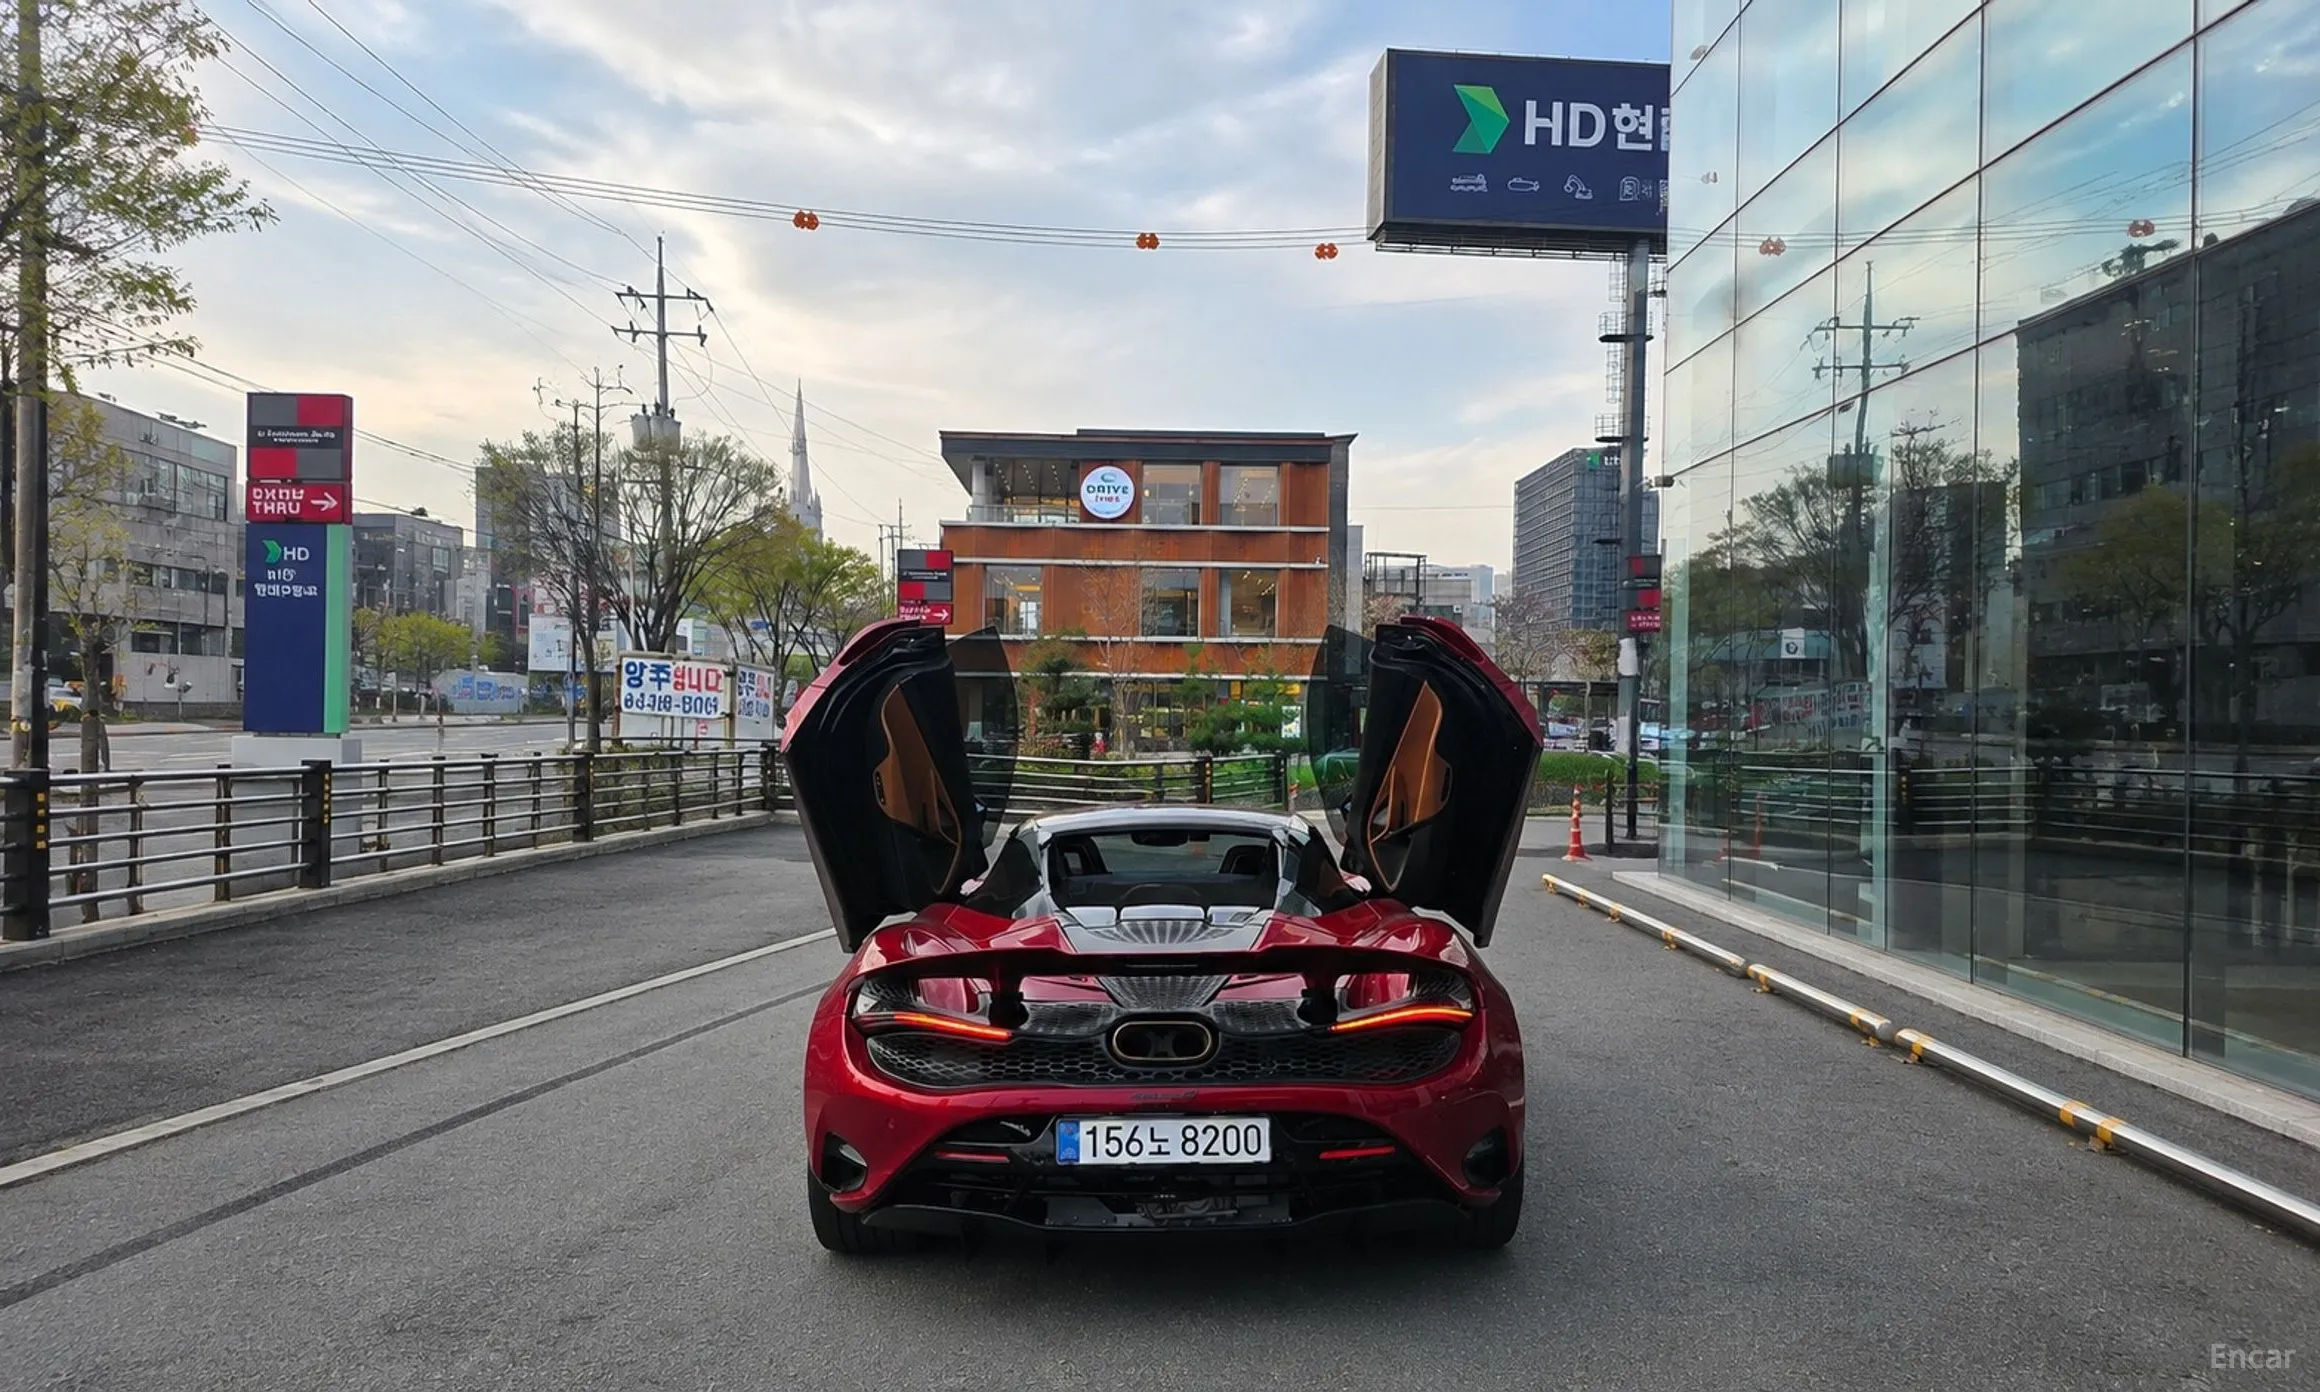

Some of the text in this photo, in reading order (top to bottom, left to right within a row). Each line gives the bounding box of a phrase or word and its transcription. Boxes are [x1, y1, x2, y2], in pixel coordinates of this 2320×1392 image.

[283, 546, 310, 561] HD
[1086, 1124, 1262, 1158] 156노 8200
